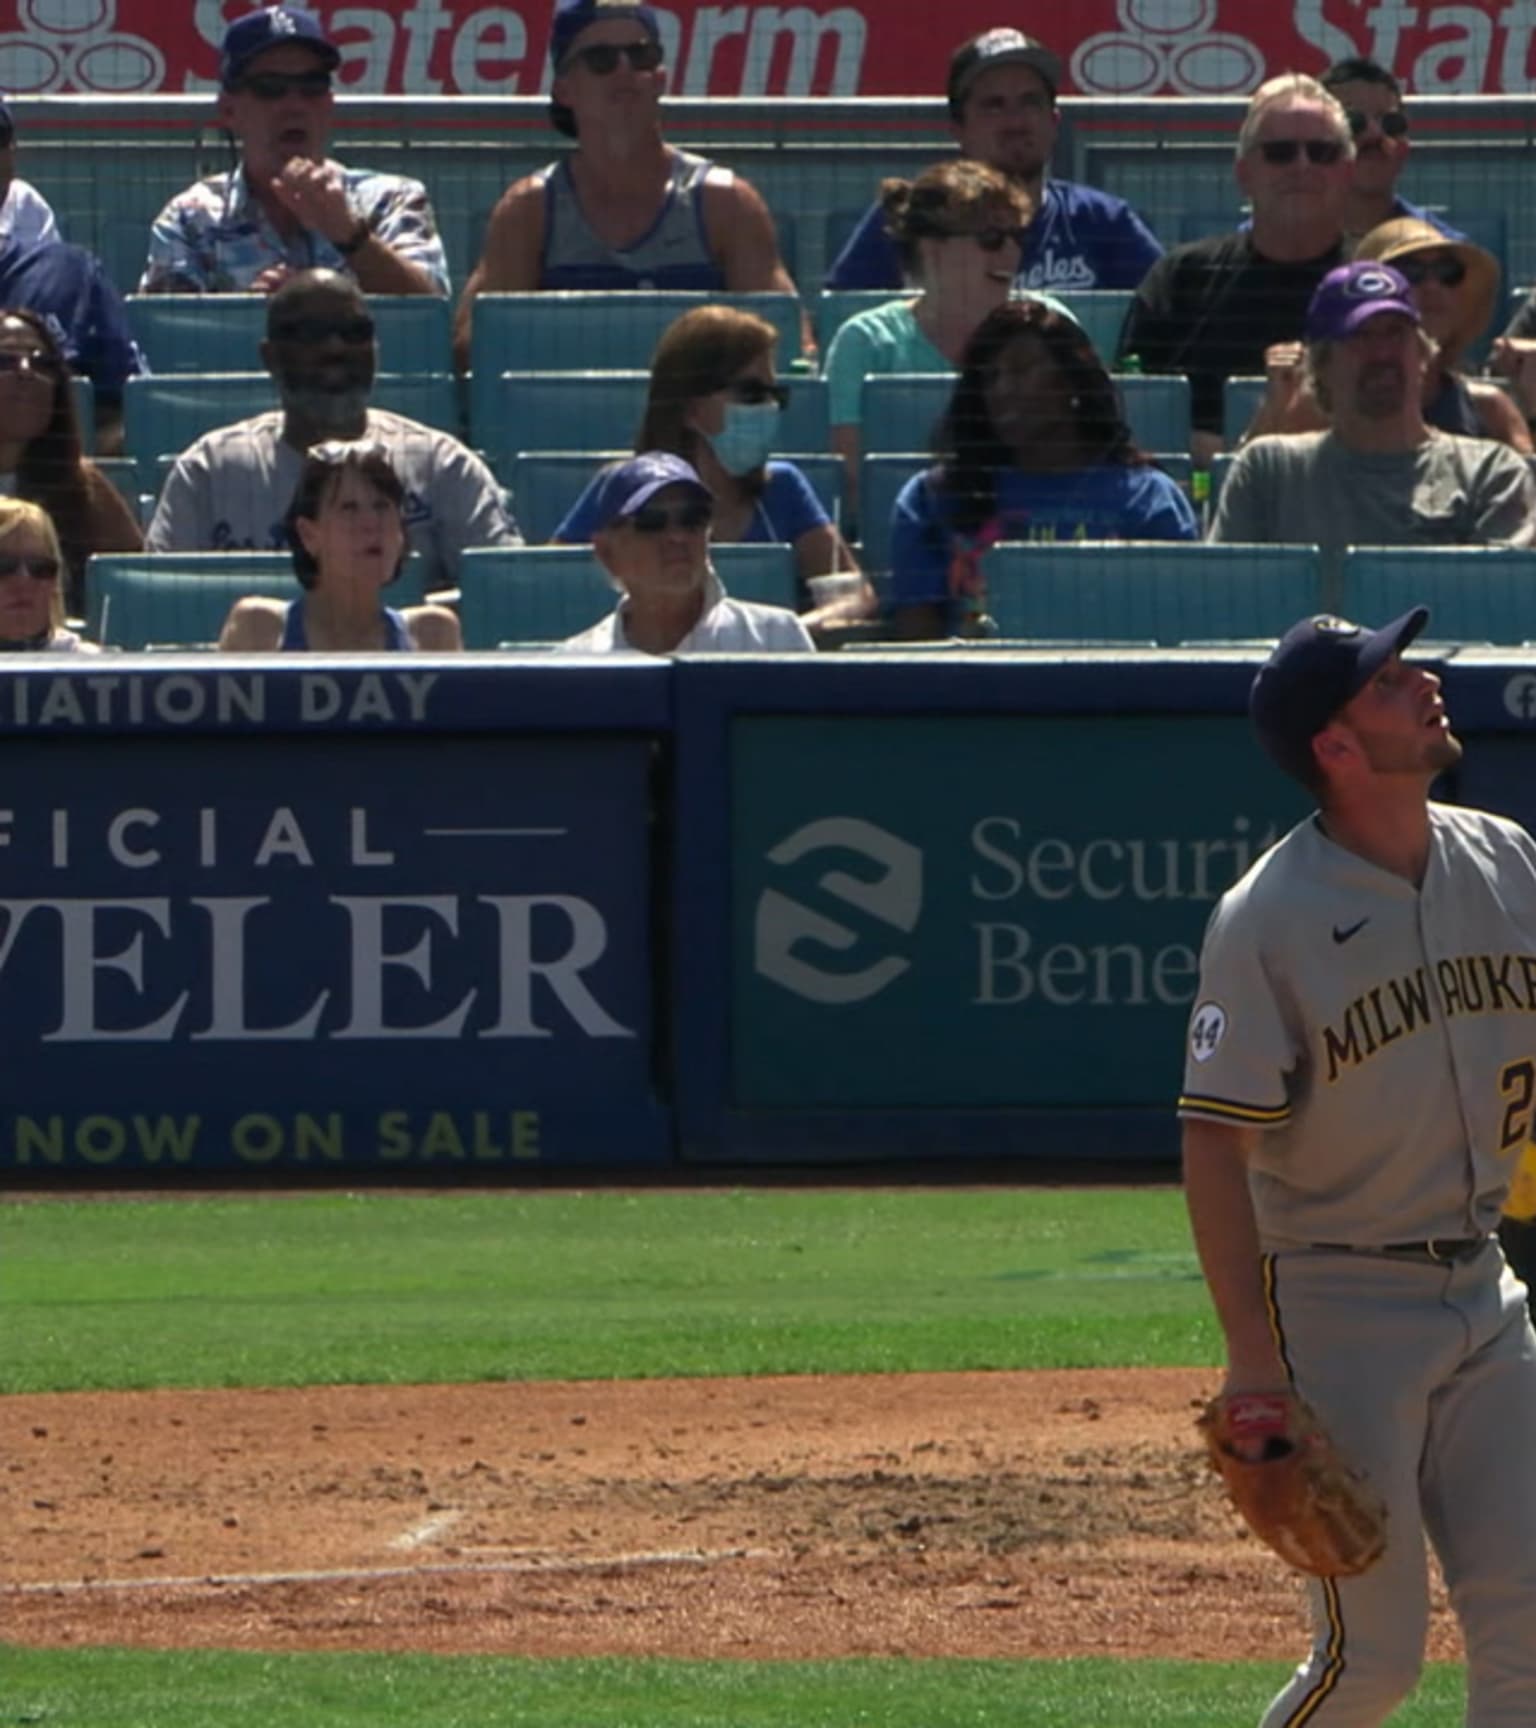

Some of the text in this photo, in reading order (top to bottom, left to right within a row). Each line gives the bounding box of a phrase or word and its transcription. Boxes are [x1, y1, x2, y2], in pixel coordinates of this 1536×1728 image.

[301, 673, 441, 722] DAY
[971, 815, 1277, 901] Securi
[1193, 1016, 1220, 1050] 44
[1498, 1056, 1536, 1152] 2
[14, 1110, 542, 1164] NOW ON SALE
